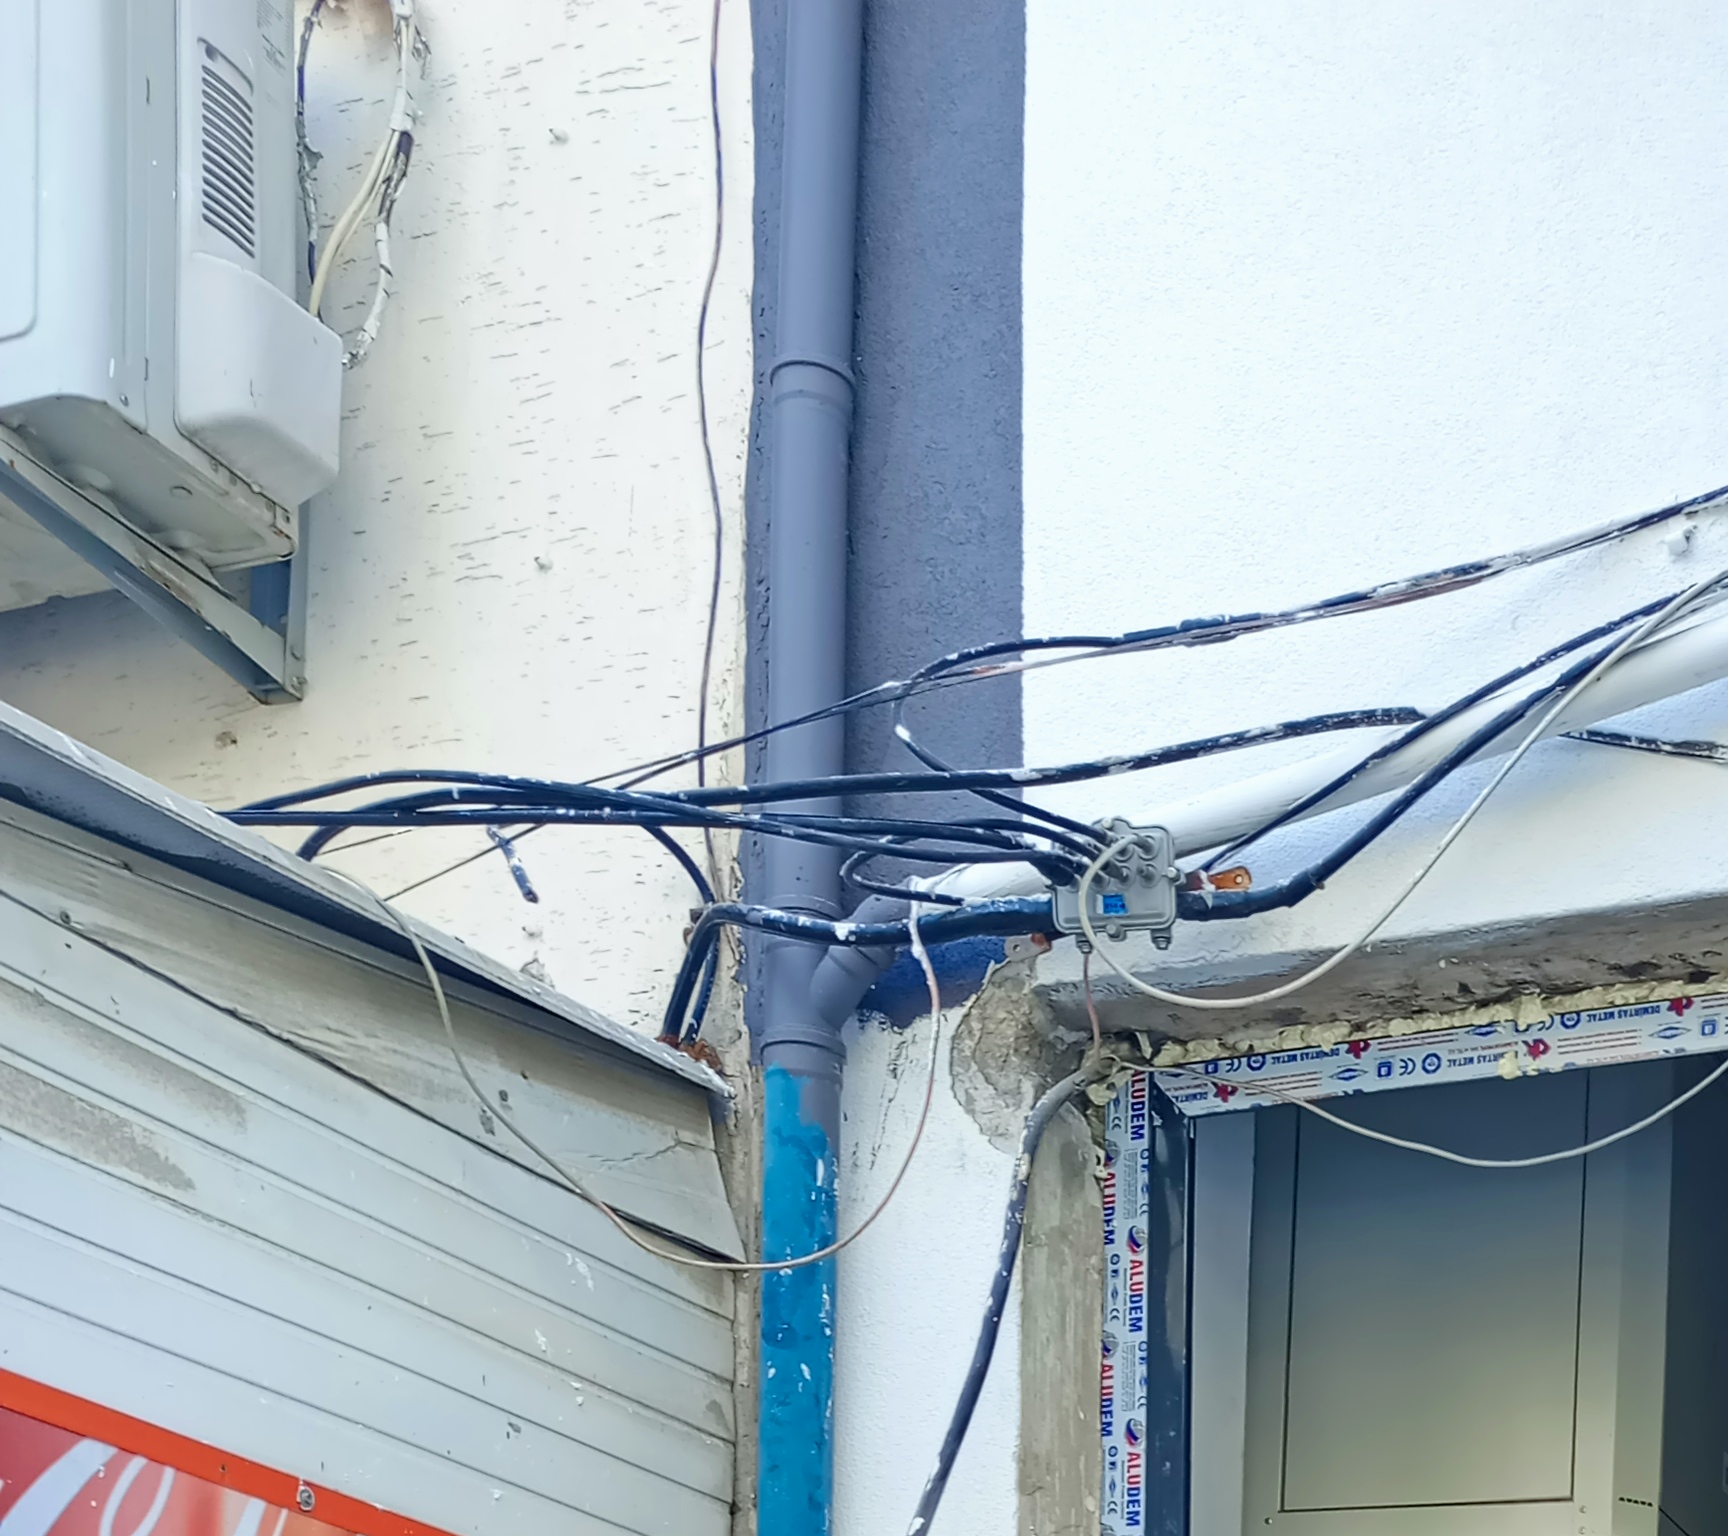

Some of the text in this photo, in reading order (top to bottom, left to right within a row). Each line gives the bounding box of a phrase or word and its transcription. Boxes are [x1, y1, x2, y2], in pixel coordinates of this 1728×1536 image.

[1586, 1009, 1616, 1024] METAL
[1131, 1069, 1146, 1141] ALUDEM
[1129, 1259, 1143, 1333] ALUDEM
[1127, 1452, 1143, 1527] ALUDEM
